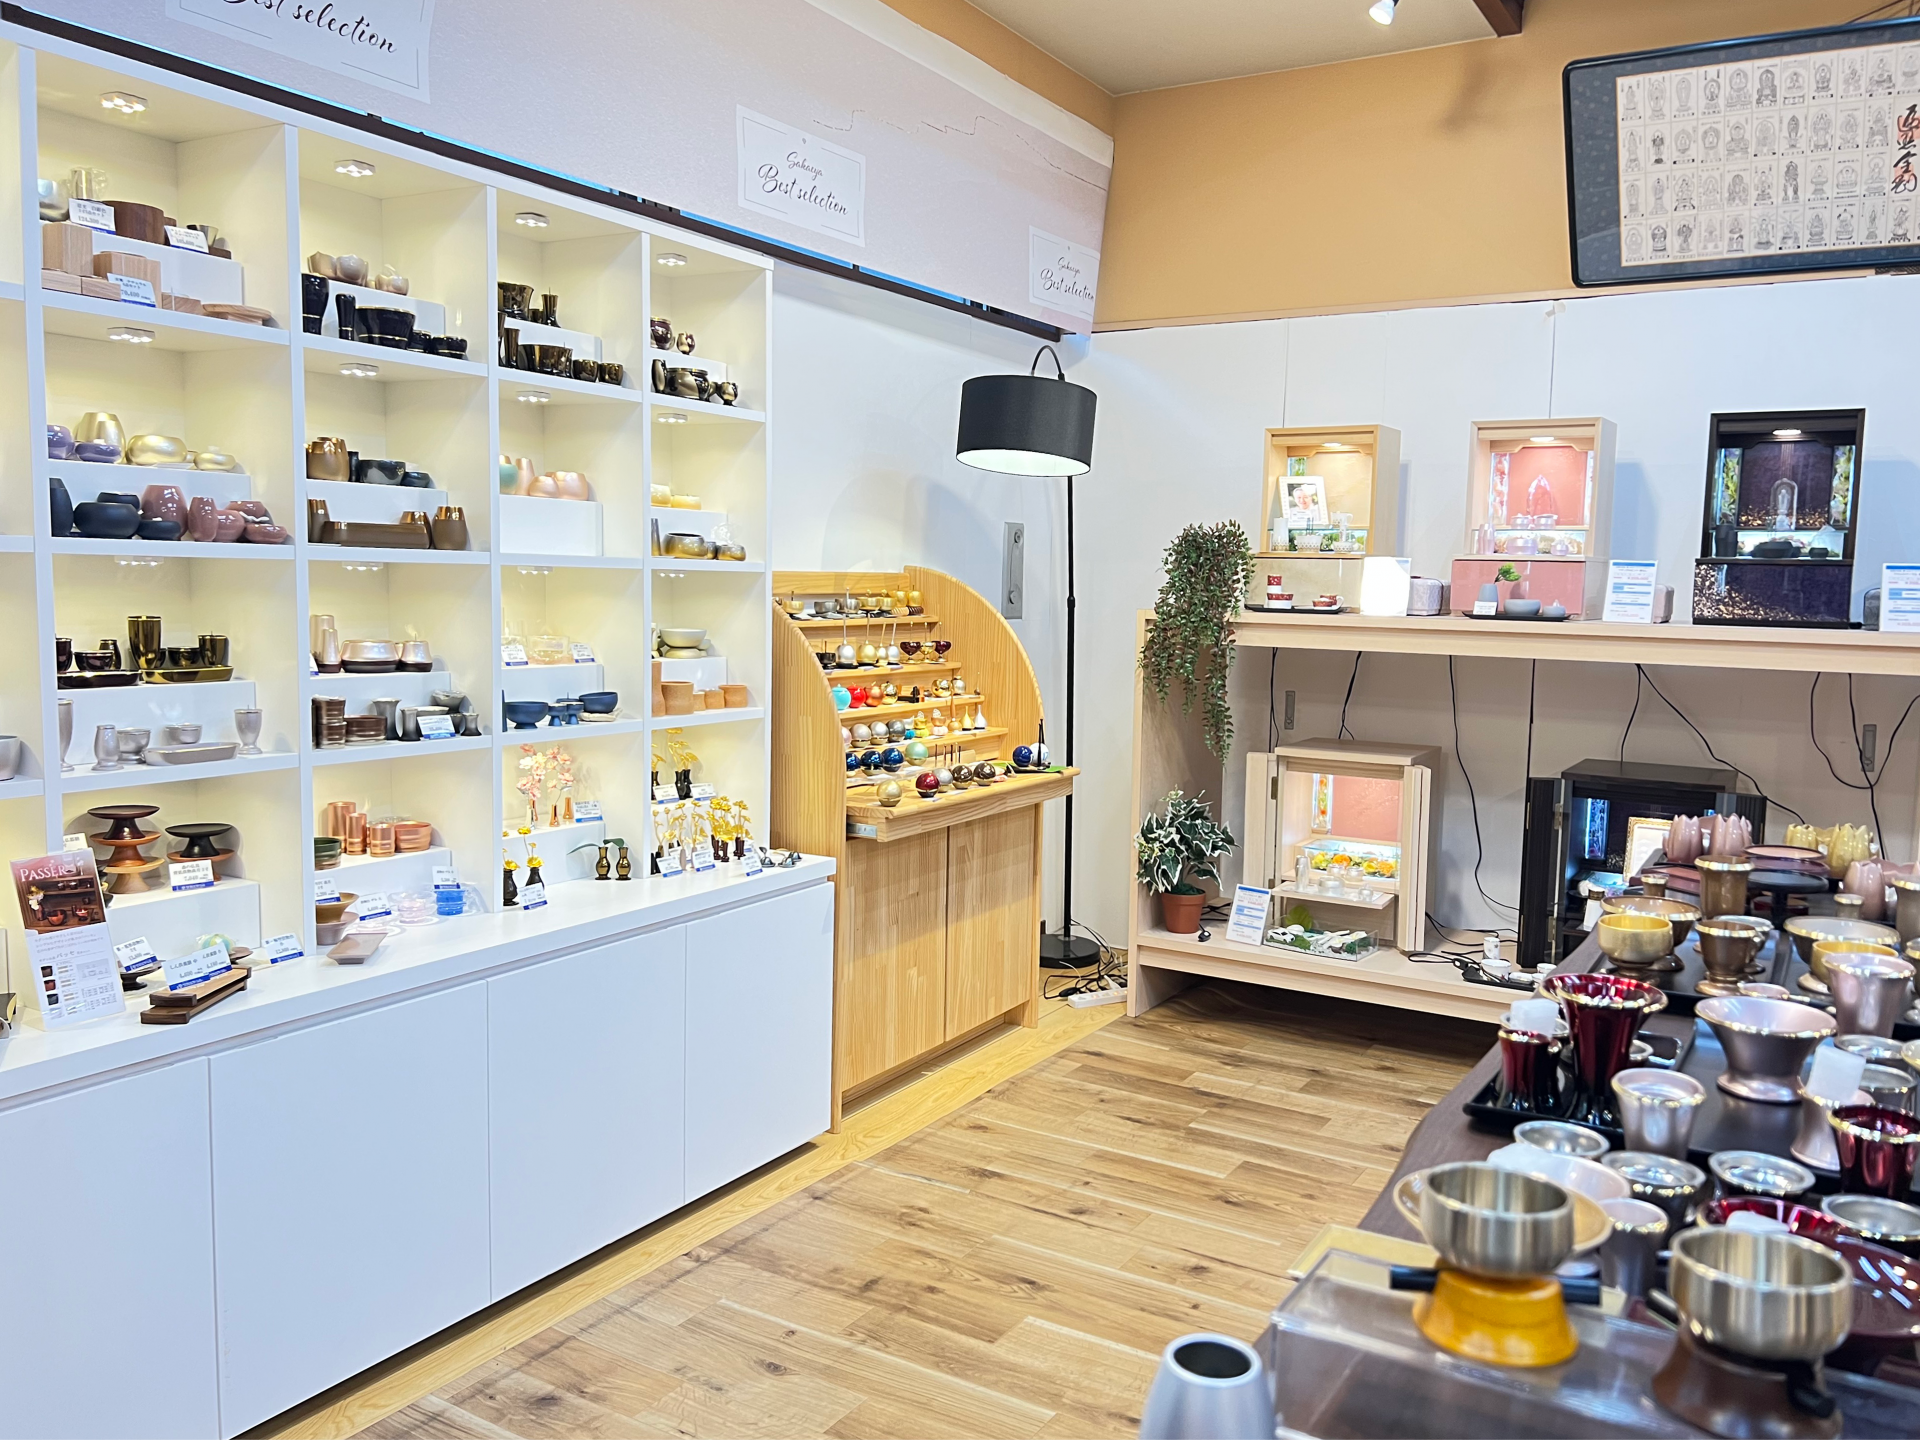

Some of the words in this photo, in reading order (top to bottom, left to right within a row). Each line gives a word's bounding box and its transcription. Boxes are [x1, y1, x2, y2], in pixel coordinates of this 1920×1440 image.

[293, 3, 397, 53] selection
[787, 152, 823, 180] Sakaya
[758, 164, 797, 199] Best
[797, 186, 848, 215] selection
[1041, 268, 1064, 292] Best
